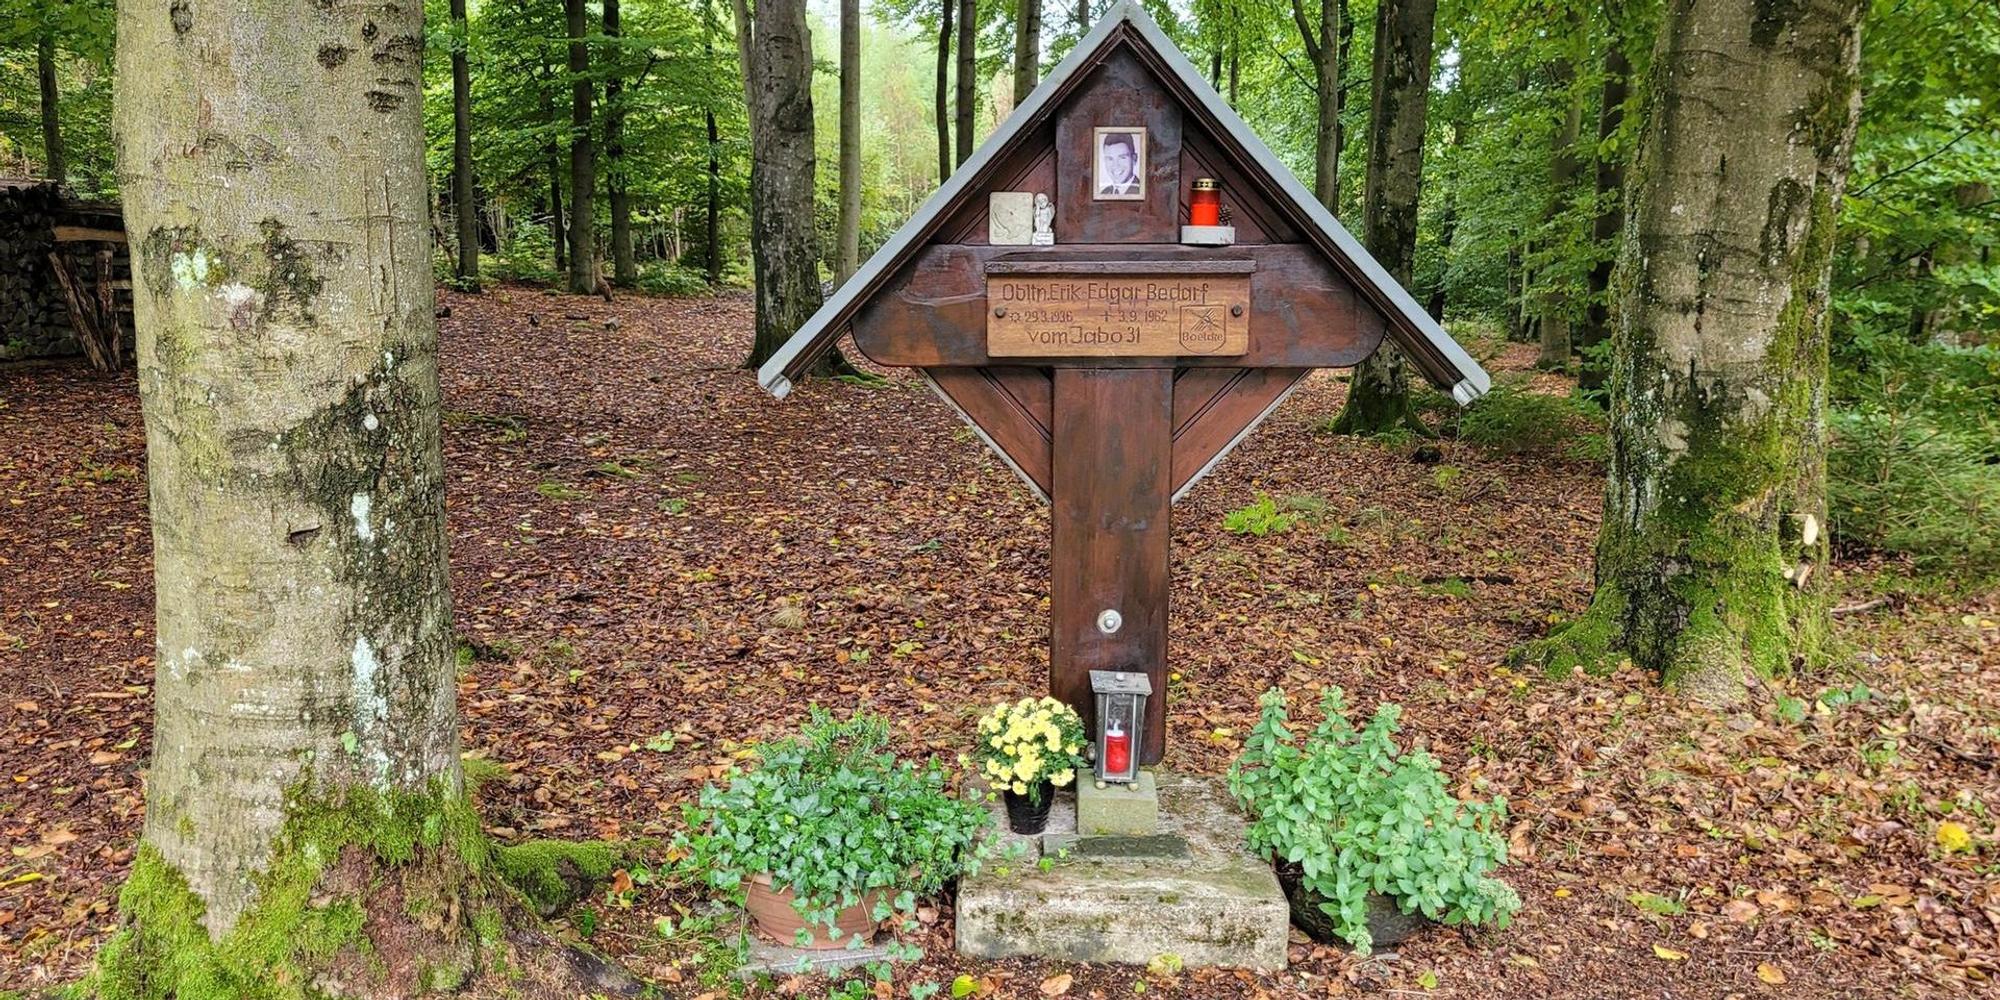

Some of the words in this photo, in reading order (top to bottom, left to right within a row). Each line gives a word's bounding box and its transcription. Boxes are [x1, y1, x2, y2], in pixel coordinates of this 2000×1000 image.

[1088, 282, 1141, 305] Edgar
[1147, 282, 1209, 304] Bedarf
[1127, 326, 1141, 344] 31
